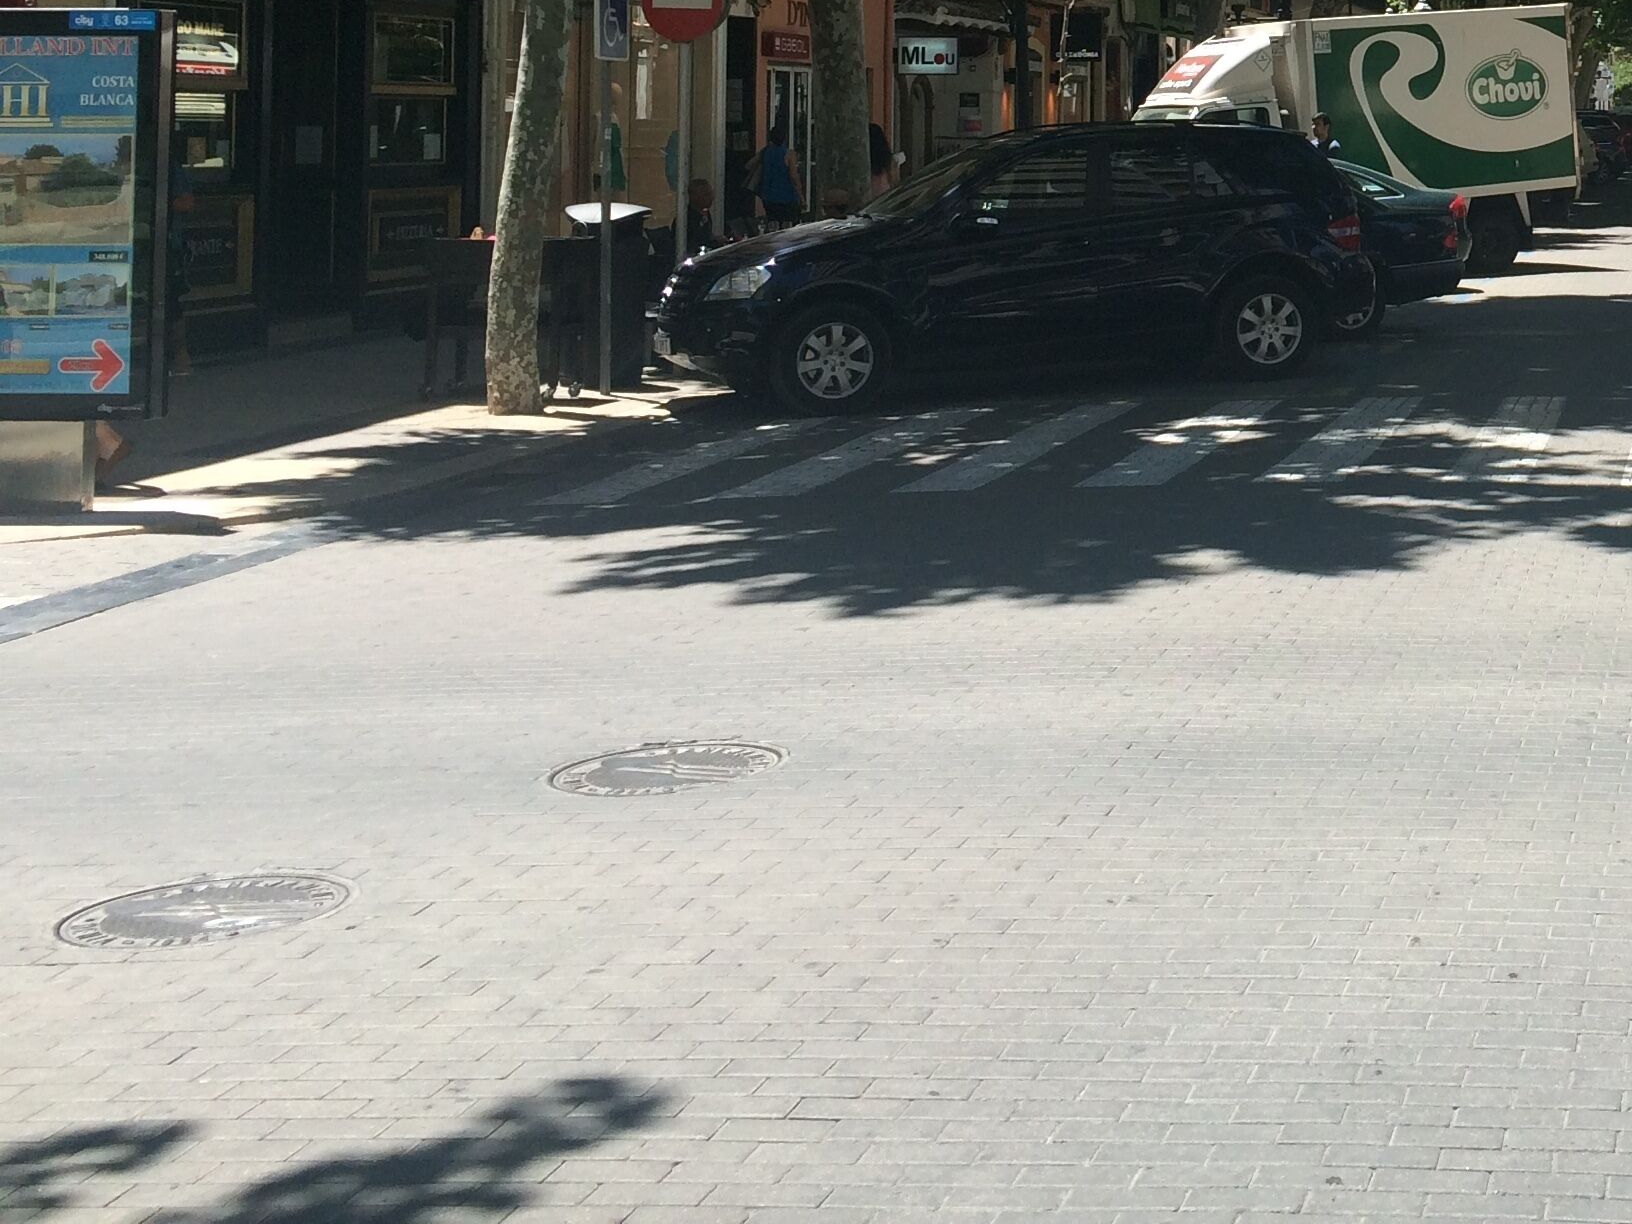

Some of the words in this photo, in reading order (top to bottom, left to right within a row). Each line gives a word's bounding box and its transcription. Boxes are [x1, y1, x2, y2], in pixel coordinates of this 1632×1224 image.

[75, 14, 94, 26] city
[114, 14, 128, 26] 63
[92, 75, 135, 88] COSTA
[1472, 73, 1541, 105] Chovi
[79, 93, 135, 106] BLANCA
